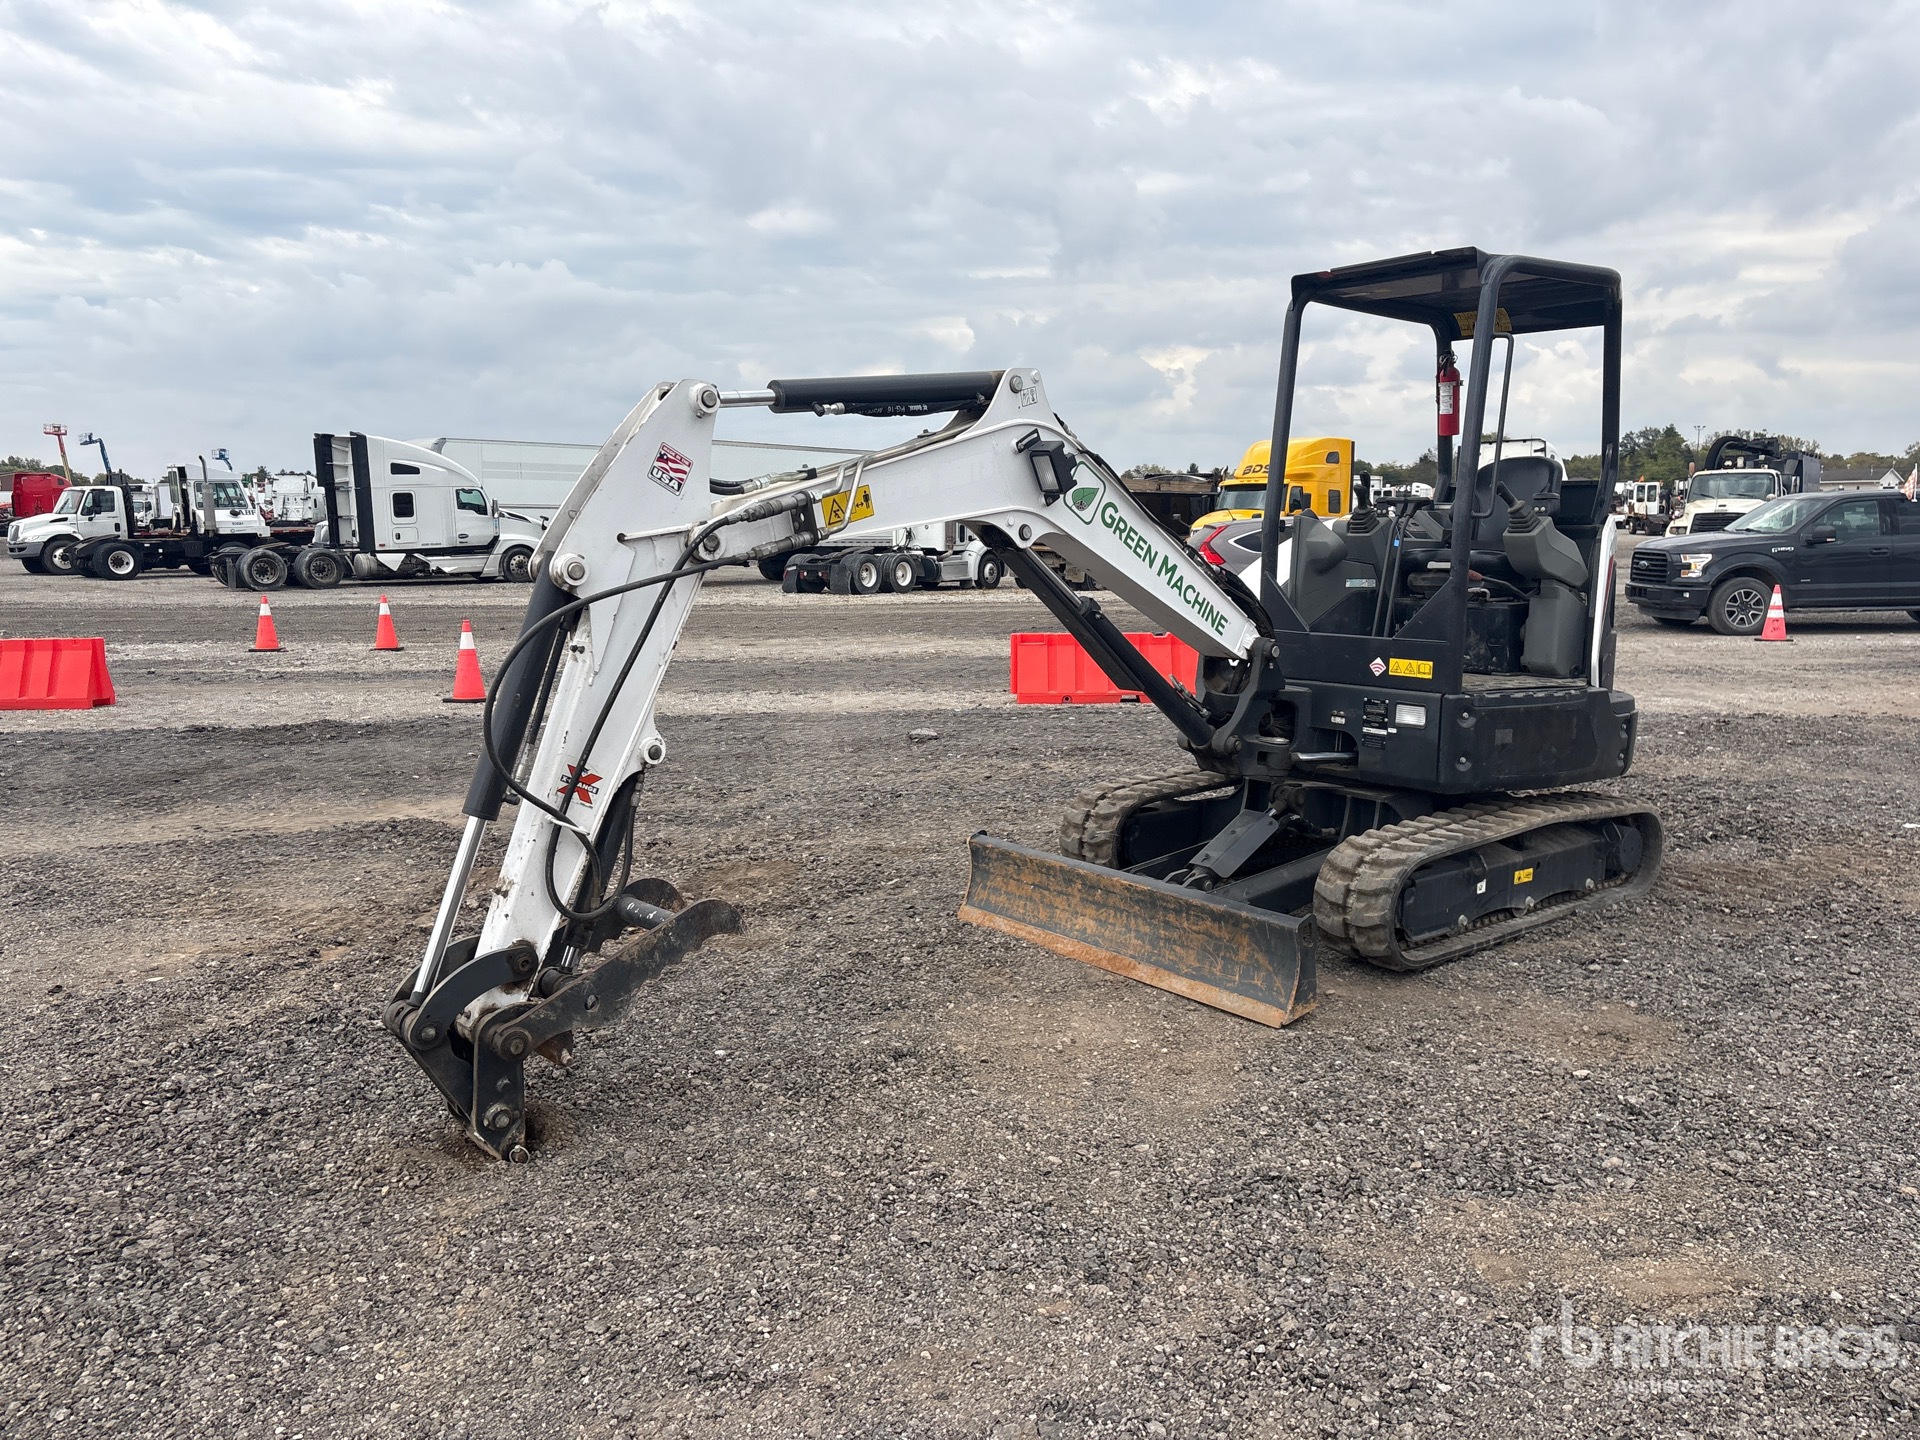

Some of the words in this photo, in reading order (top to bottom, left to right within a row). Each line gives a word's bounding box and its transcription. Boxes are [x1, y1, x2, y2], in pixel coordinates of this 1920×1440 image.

[651, 467, 679, 491] USA
[1101, 501, 1158, 569] GREEN
[1157, 554, 1228, 636] MACHINE
